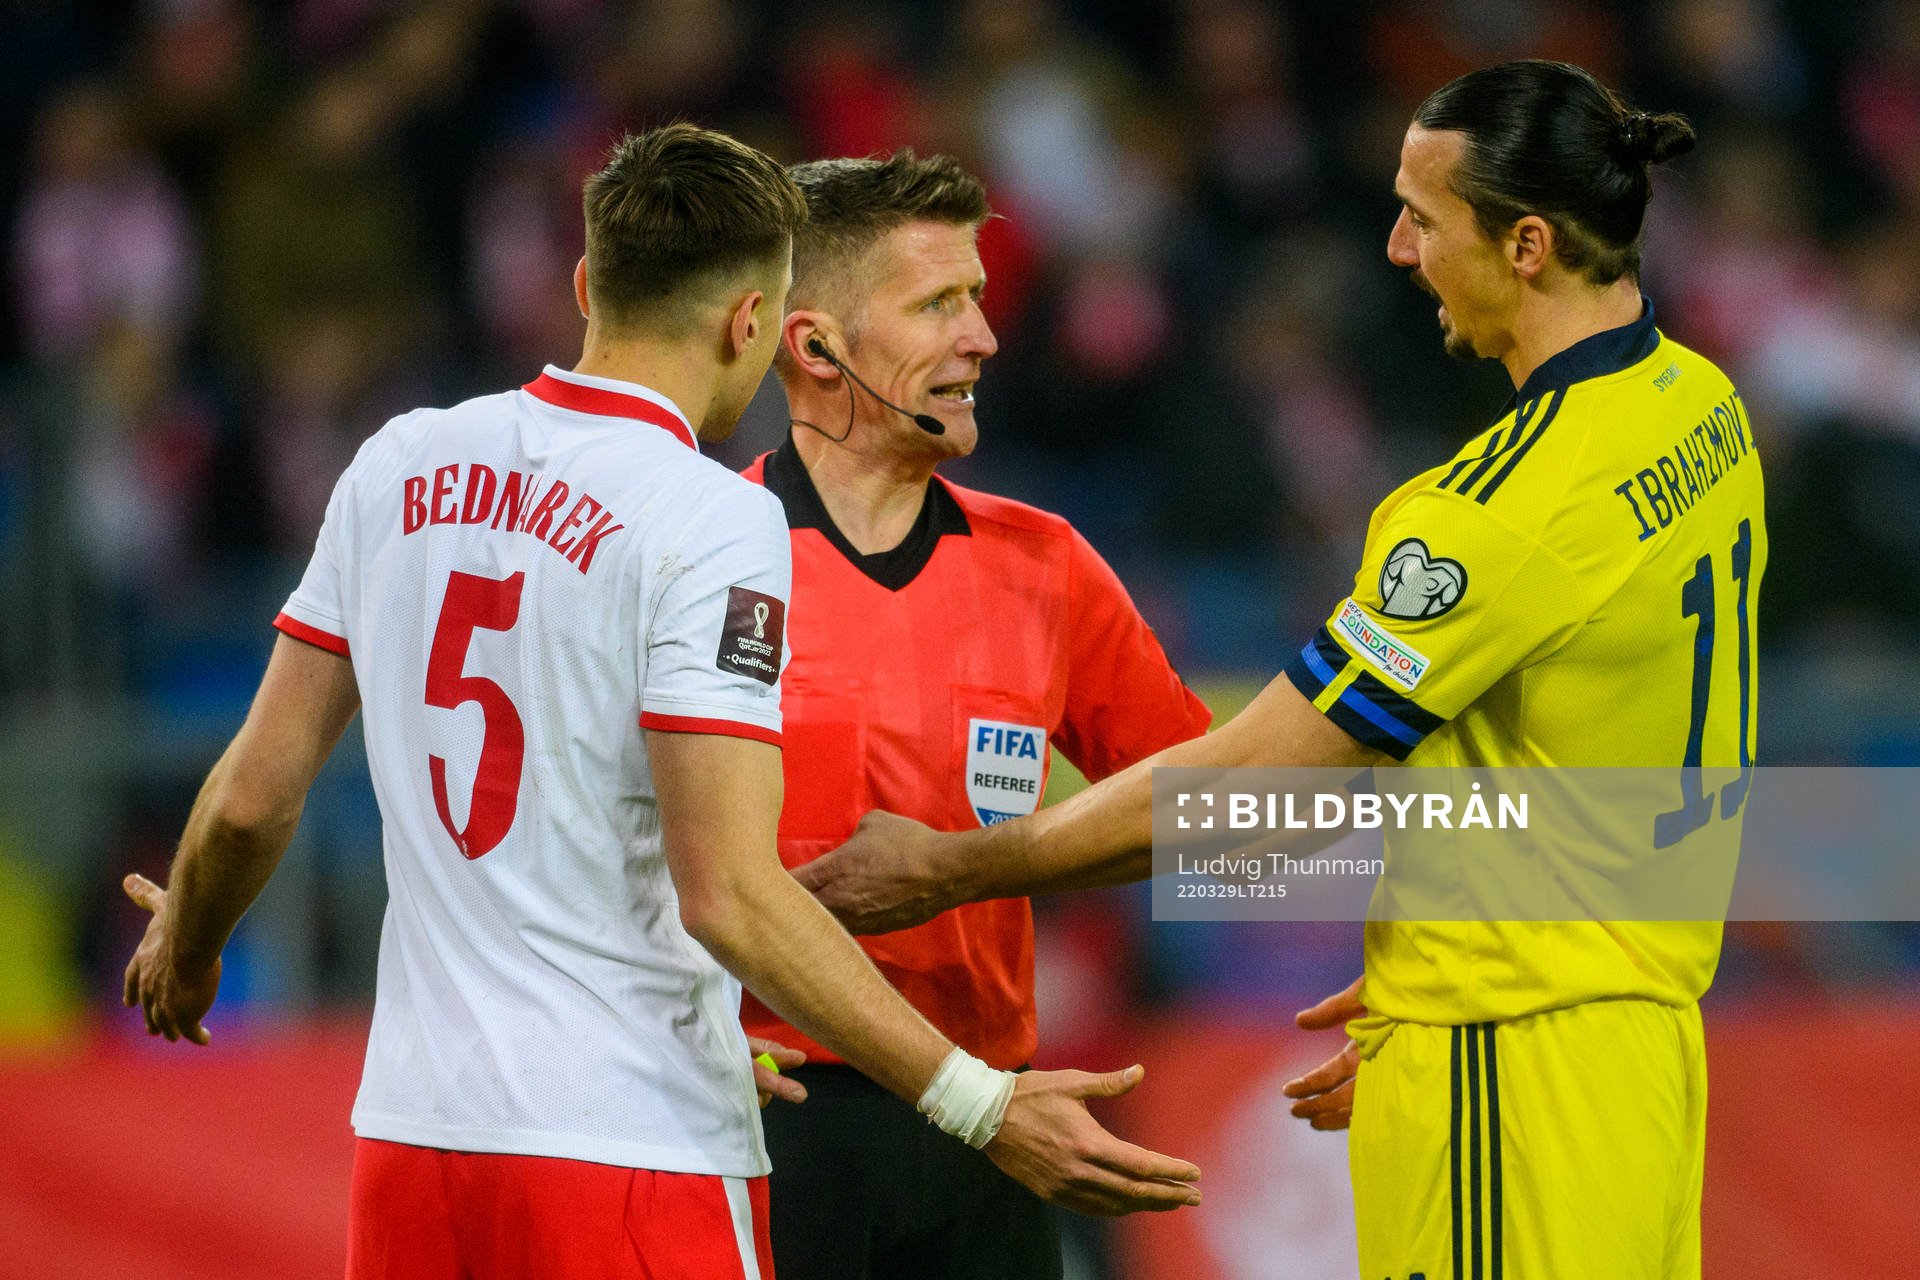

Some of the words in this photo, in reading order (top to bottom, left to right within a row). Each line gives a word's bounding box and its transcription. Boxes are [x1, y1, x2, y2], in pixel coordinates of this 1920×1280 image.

[1347, 601, 1362, 618] UEFA
[731, 653, 773, 672] Qualifiers
[1653, 517, 1754, 850] 11
[425, 570, 526, 860] 5
[976, 727, 1038, 760] FIFA
[974, 773, 1036, 794] REFEREE
